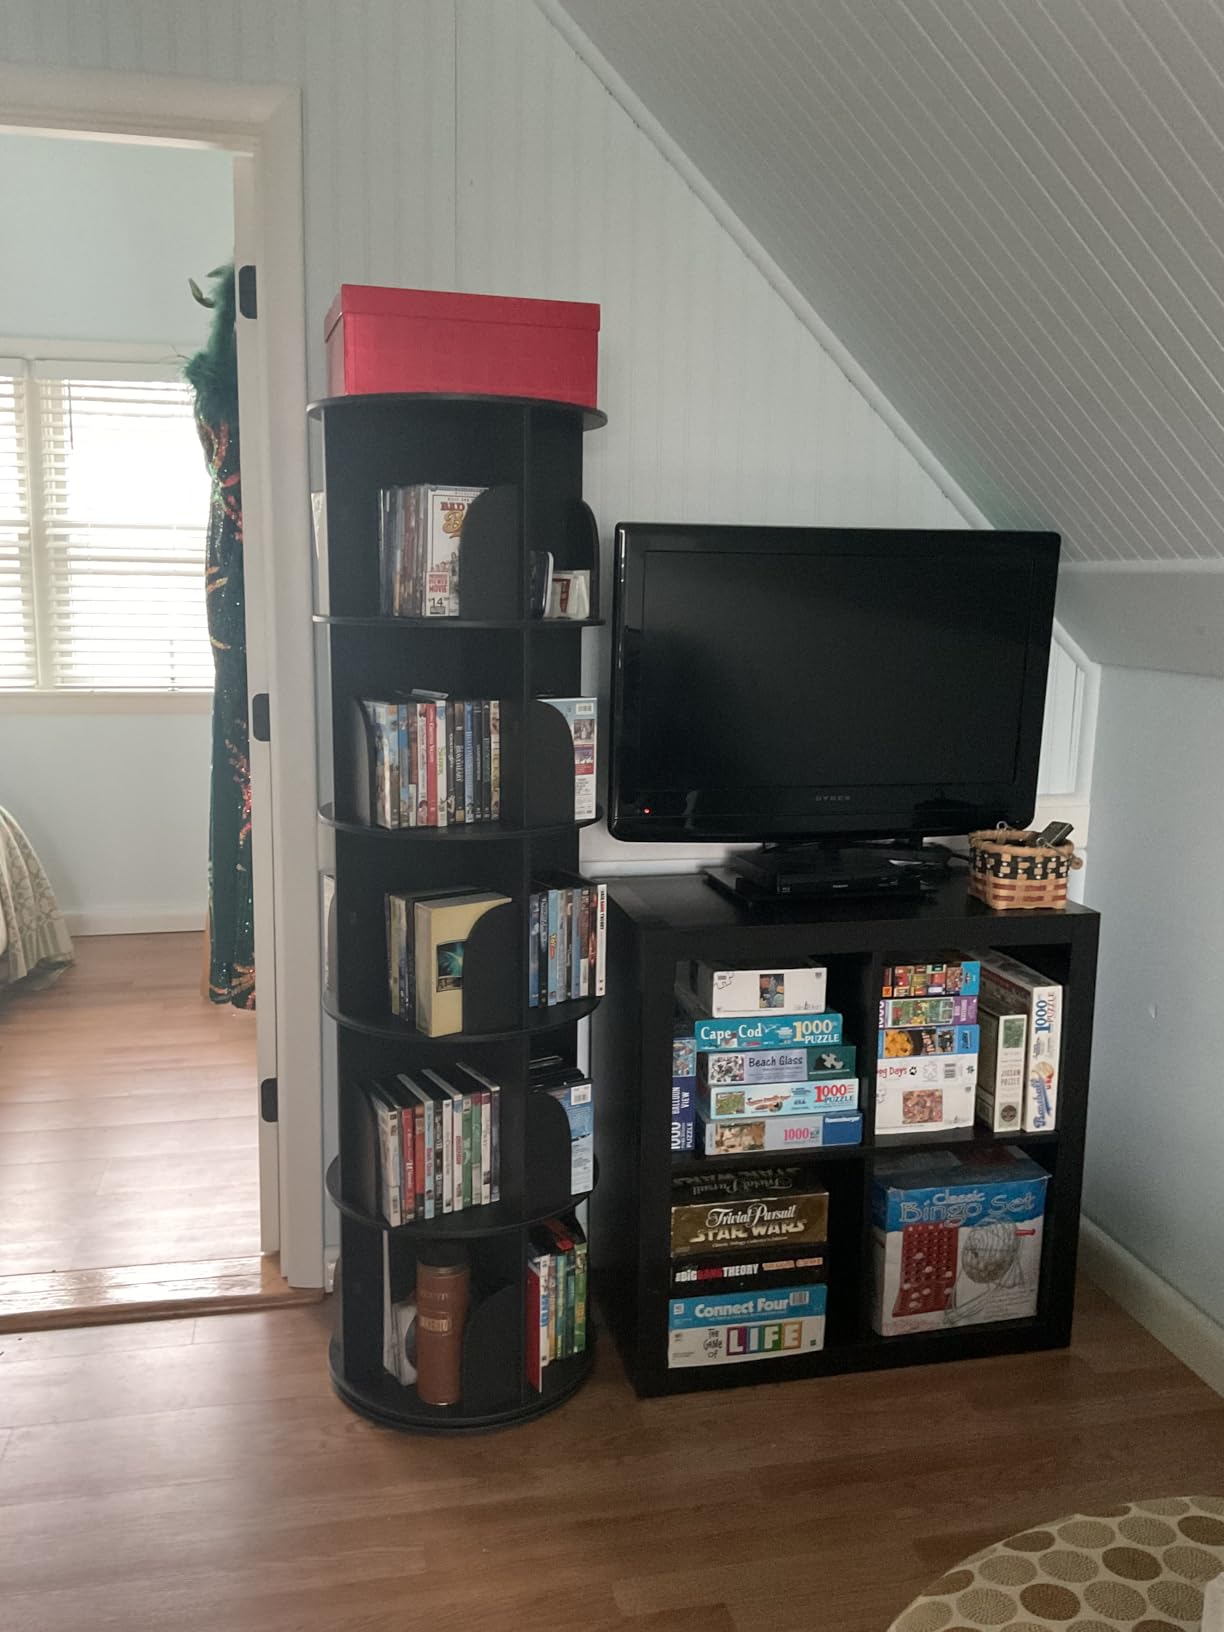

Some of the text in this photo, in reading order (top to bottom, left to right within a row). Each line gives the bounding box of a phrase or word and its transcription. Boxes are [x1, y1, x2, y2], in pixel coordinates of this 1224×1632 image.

[1036, 999, 1051, 1034] 1000
[700, 1023, 763, 1045] Cape Cod
[793, 1019, 832, 1042] 1000
[804, 1033, 840, 1044] PUZZLE
[748, 1055, 803, 1068] Beach Glass
[682, 1091, 690, 1108] VIEW
[813, 1084, 847, 1103] 1000
[823, 1094, 854, 1103] PUZZLE
[1033, 1078, 1046, 1127] Baseball
[783, 1127, 809, 1141] 1000
[932, 1189, 986, 1205] Classic
[706, 1203, 798, 1228] Trivial Pursuit
[900, 1192, 1036, 1228] Bingo Set
[690, 1227, 748, 1243] STAR
[751, 1219, 808, 1236] WARS
[723, 1263, 759, 1278] THEORY
[694, 1300, 754, 1318] Connect
[757, 1297, 789, 1312] Four
[728, 1323, 801, 1353] LIFE
